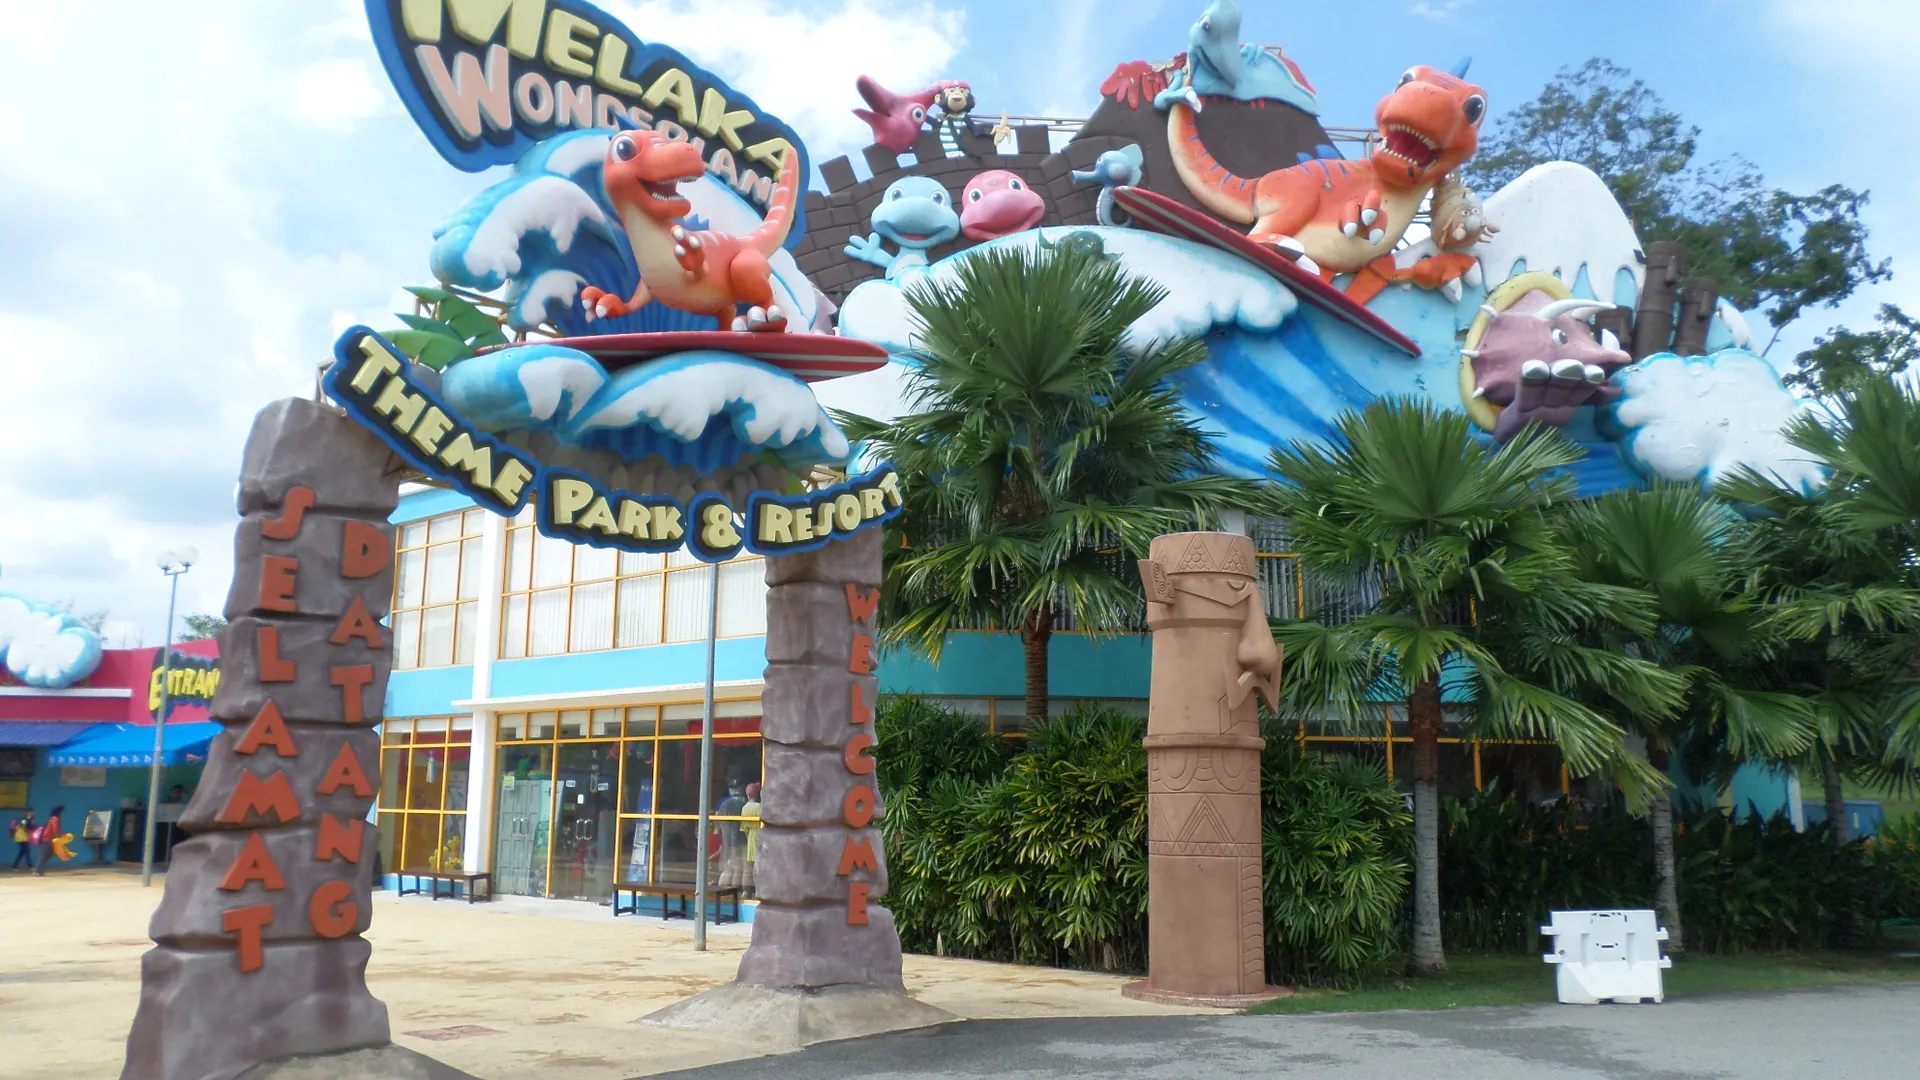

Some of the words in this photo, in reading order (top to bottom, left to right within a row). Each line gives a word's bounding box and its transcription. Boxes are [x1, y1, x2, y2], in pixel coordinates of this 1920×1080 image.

[402, 0, 789, 182] MELAKA
[414, 43, 778, 211] WONDERAN
[350, 335, 535, 507] THEME
[553, 478, 685, 541] PARK
[701, 503, 742, 549] &
[758, 471, 903, 543] RESORT
[149, 666, 220, 711] ENTRAN
[217, 485, 316, 974] SELAMAT
[308, 520, 392, 939] DATANG
[836, 583, 881, 926] WELCOME
